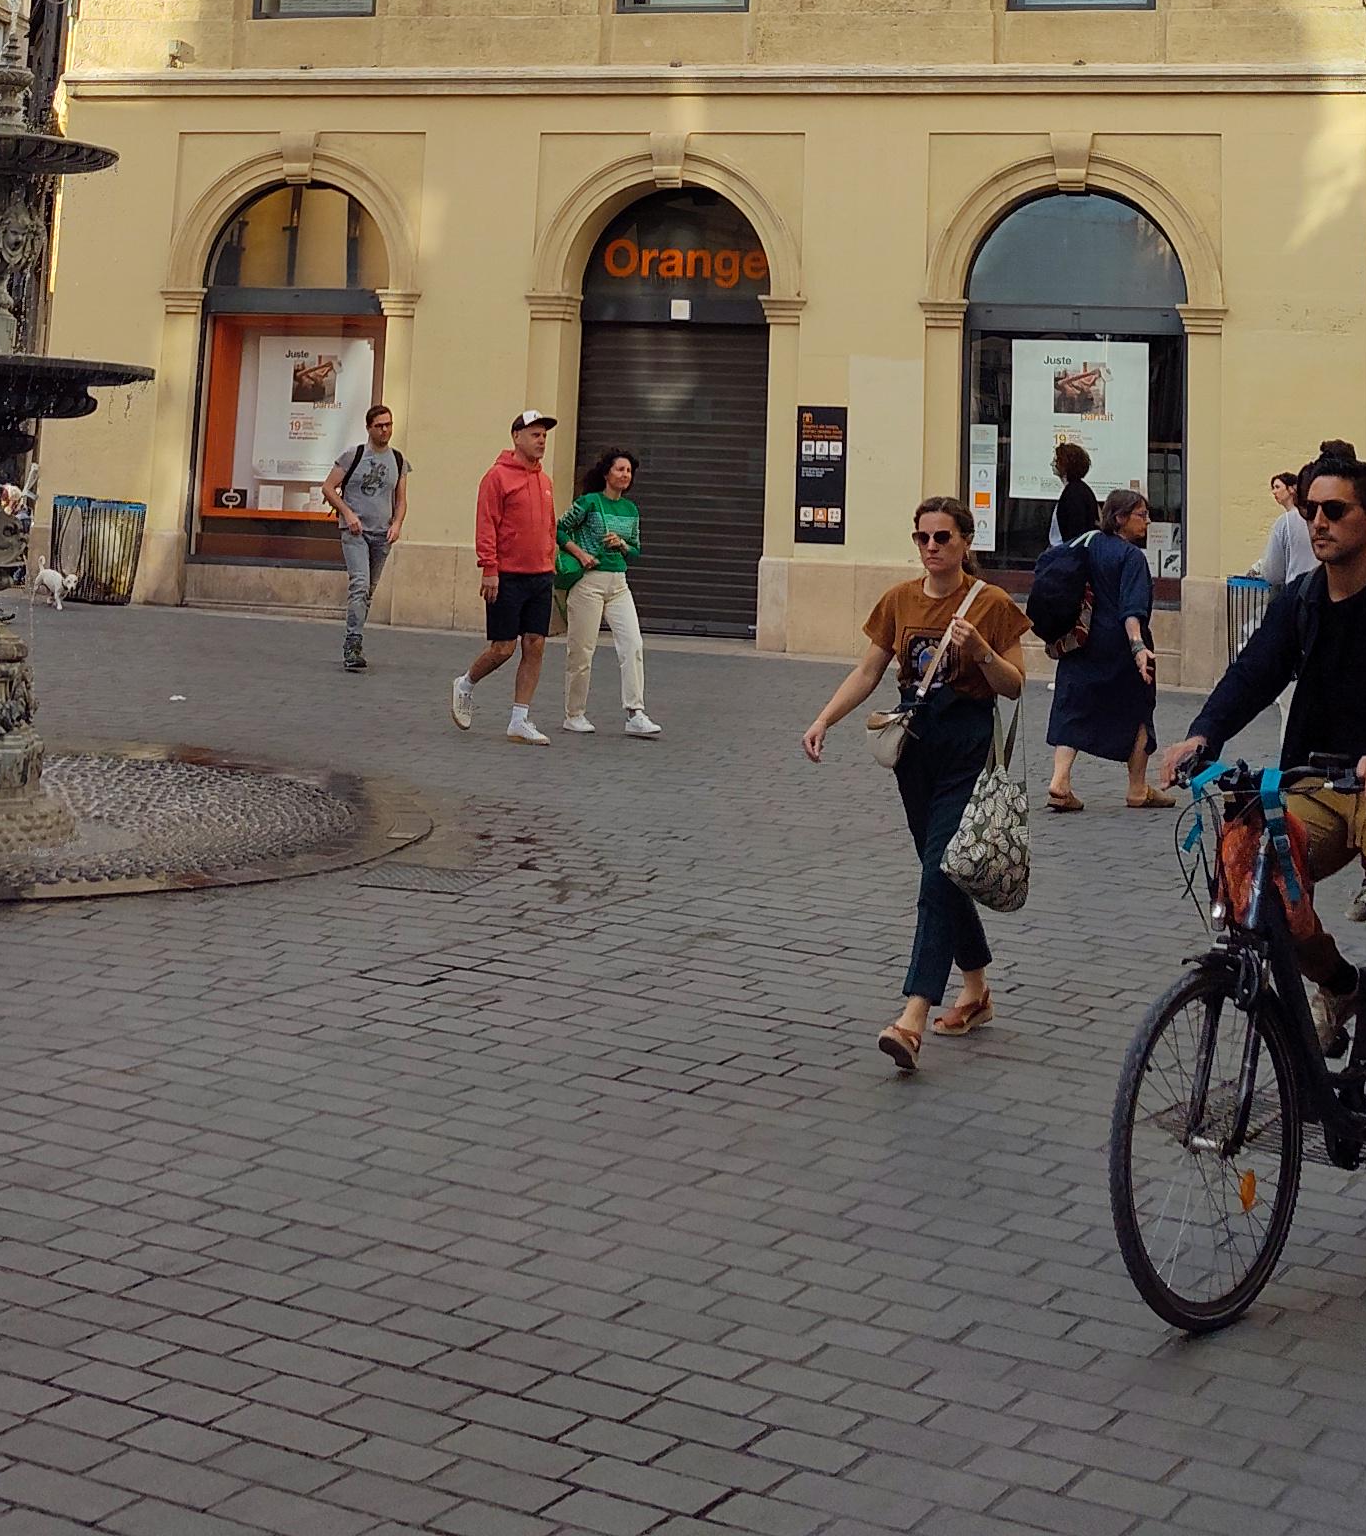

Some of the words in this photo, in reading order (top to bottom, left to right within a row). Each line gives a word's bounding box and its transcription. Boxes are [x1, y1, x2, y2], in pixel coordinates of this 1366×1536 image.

[604, 239, 767, 289] Orange
[285, 349, 309, 359] Juste
[1044, 355, 1072, 365] Juste
[290, 420, 301, 431] 19
